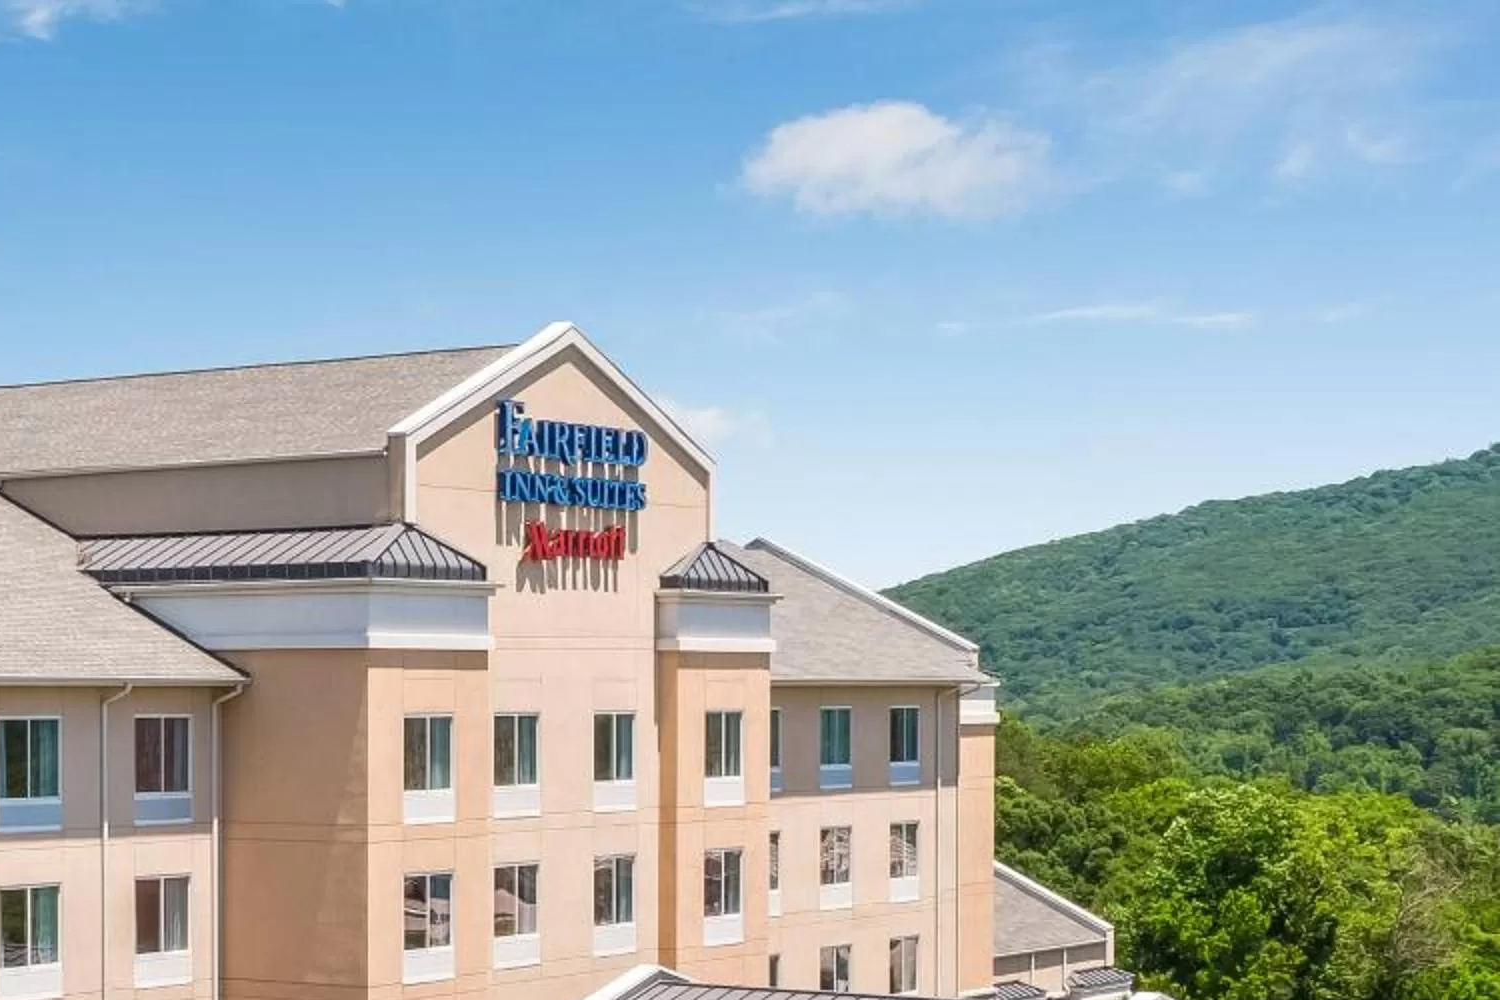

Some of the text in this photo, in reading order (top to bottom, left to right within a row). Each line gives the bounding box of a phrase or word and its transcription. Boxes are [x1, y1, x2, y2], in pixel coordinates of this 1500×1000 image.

[497, 400, 648, 466] FAIRFIELD
[572, 476, 646, 511] SUITES
[522, 520, 625, 560] Marriott
